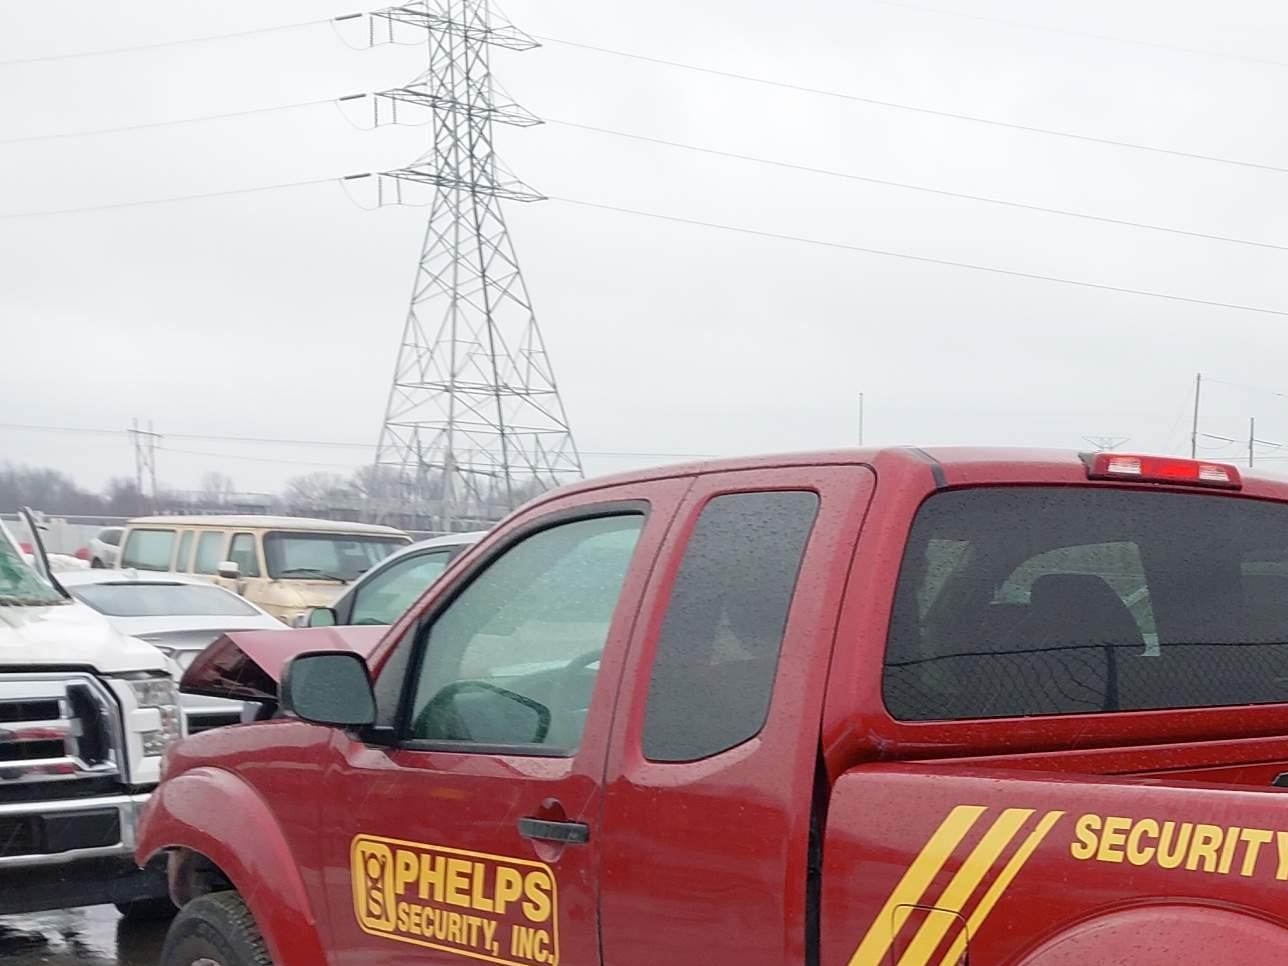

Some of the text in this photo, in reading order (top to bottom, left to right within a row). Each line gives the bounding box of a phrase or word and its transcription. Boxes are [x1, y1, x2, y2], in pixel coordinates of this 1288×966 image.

[396, 849, 552, 923] PHELPS
[397, 901, 555, 964] SECURITY, INC.
